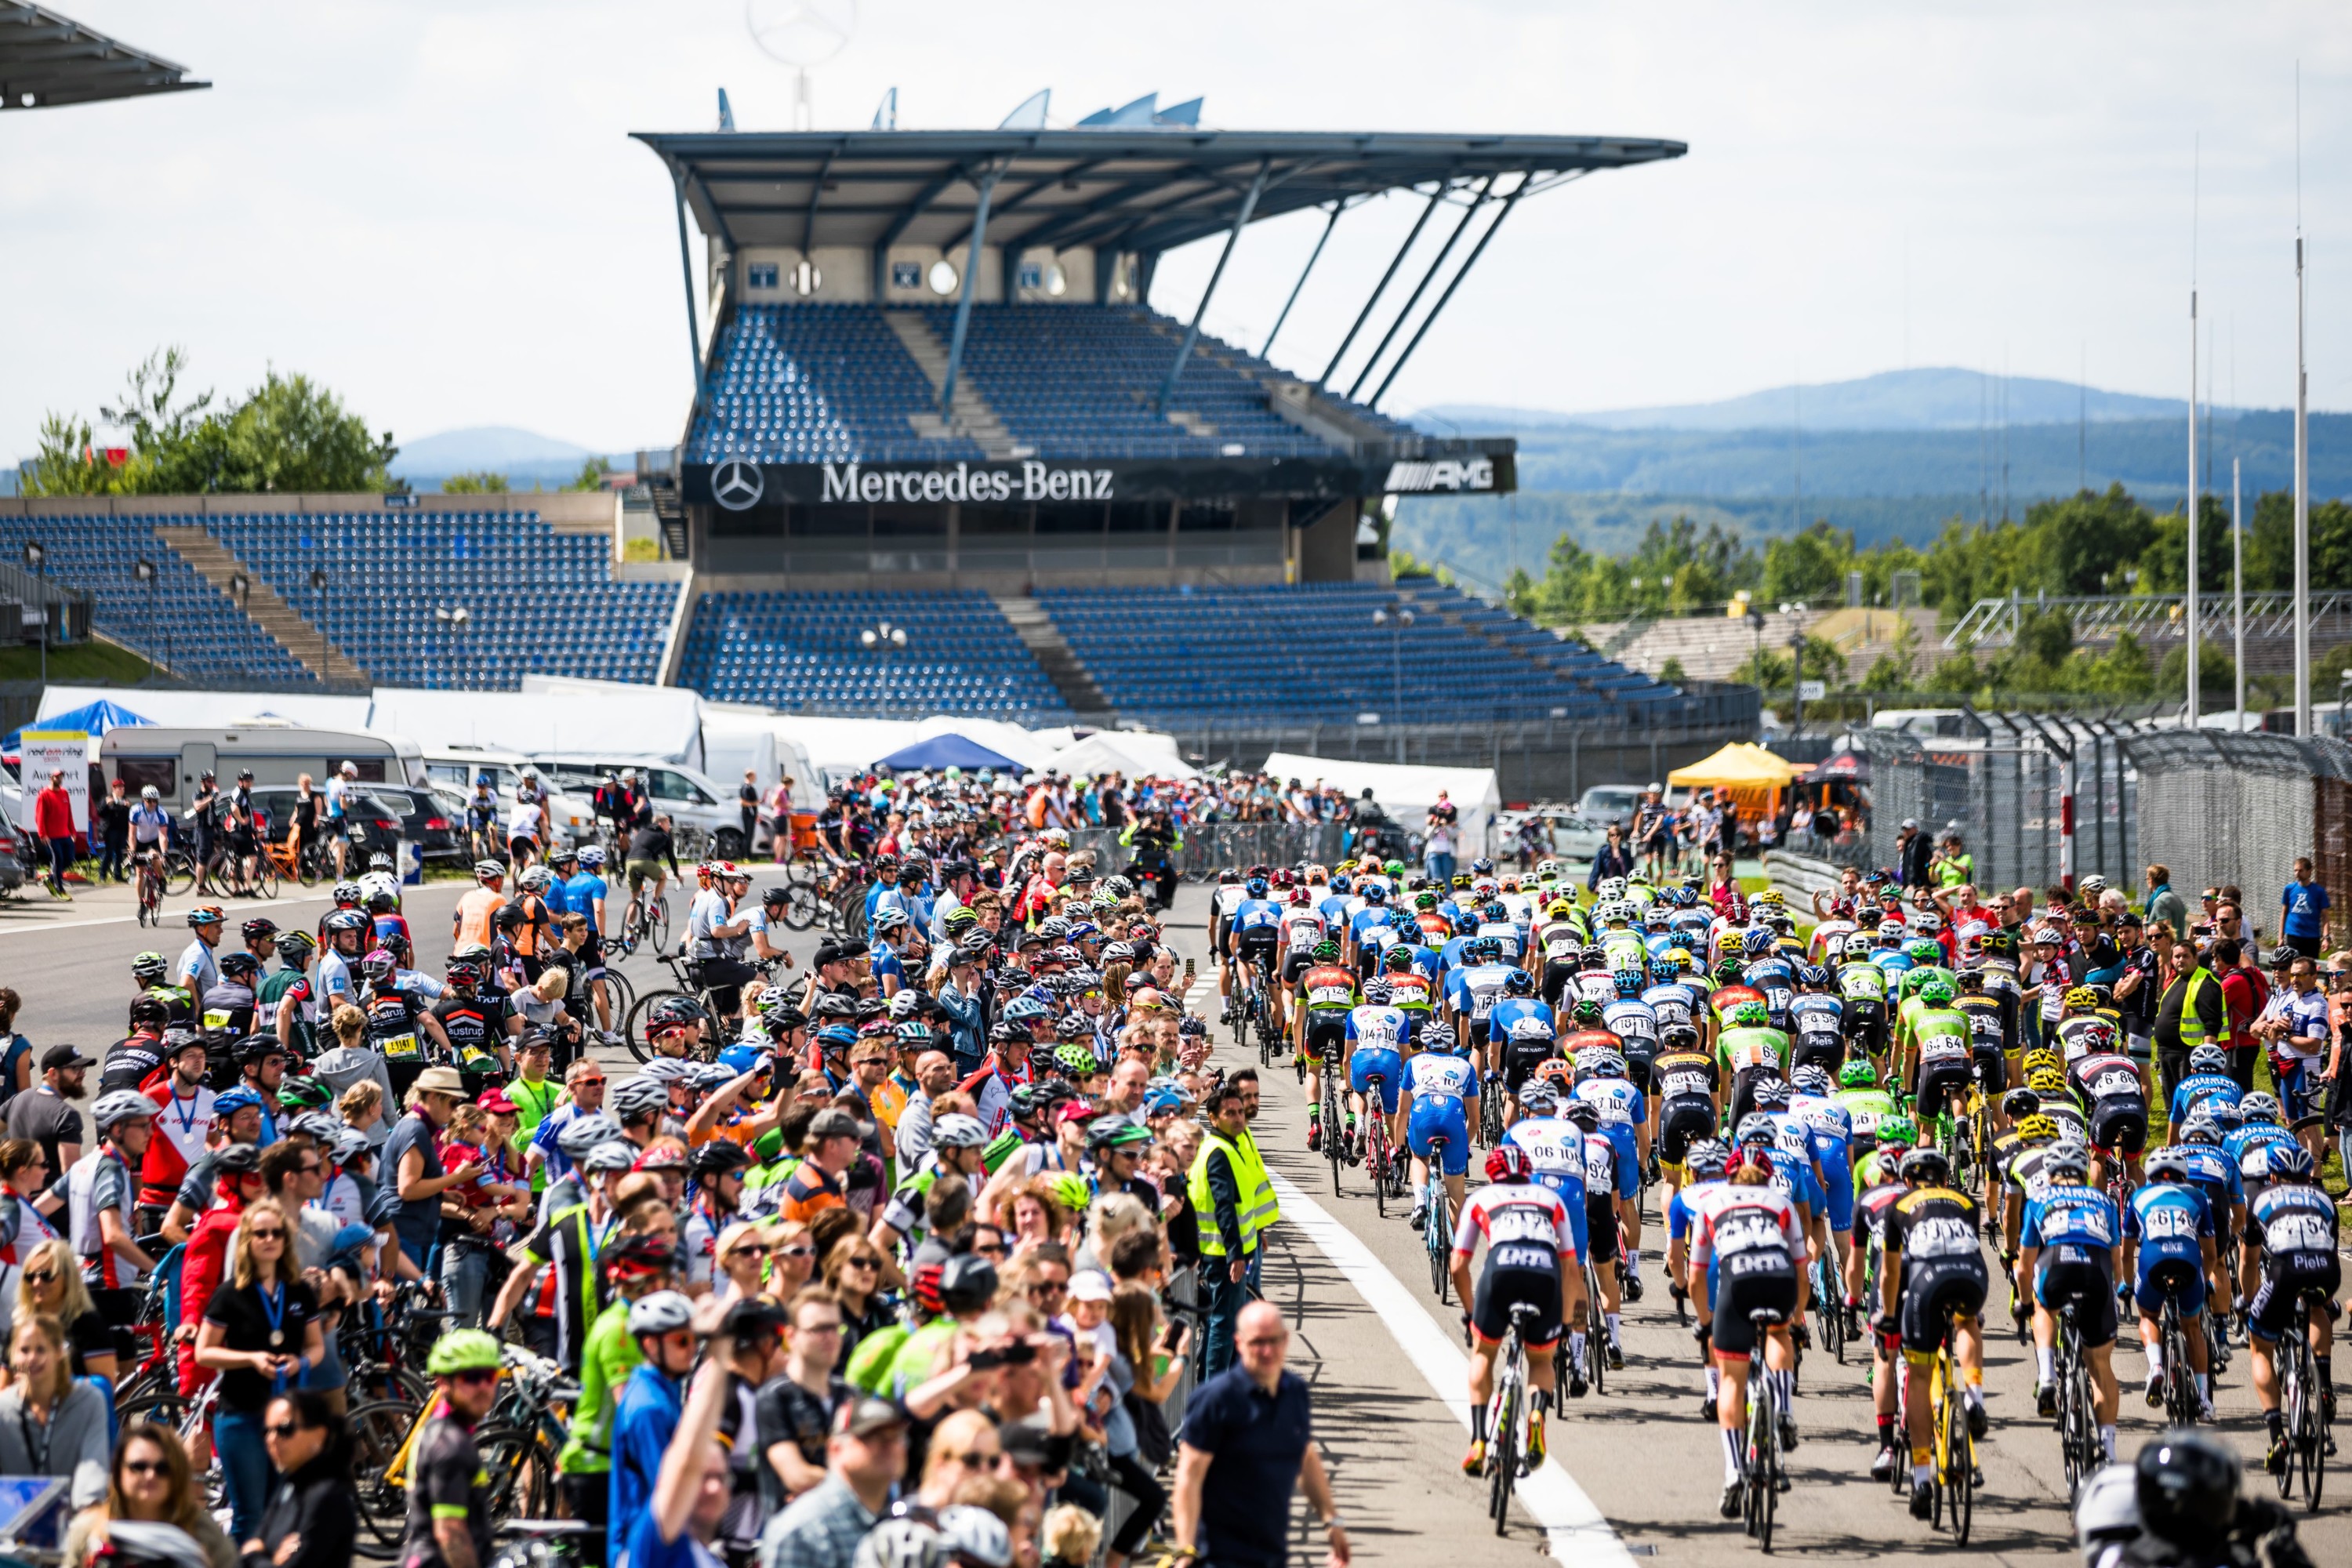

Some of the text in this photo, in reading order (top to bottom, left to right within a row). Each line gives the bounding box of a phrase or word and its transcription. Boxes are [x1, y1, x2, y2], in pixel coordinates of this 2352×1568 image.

[821, 461, 1113, 503] Mercedes-Benz
[1428, 459, 1494, 490] AMG
[32, 769, 79, 781] Aushrt
[1751, 968, 1782, 981] Piels
[369, 1007, 406, 1023] austrup
[448, 1028, 485, 1037] austrup
[1809, 1036, 1834, 1046] Piels
[1945, 1036, 1960, 1048] 64
[1588, 1161, 1607, 1180] 92
[2293, 1254, 2328, 1270] Piels
[2249, 1279, 2274, 1320] DESTIL
